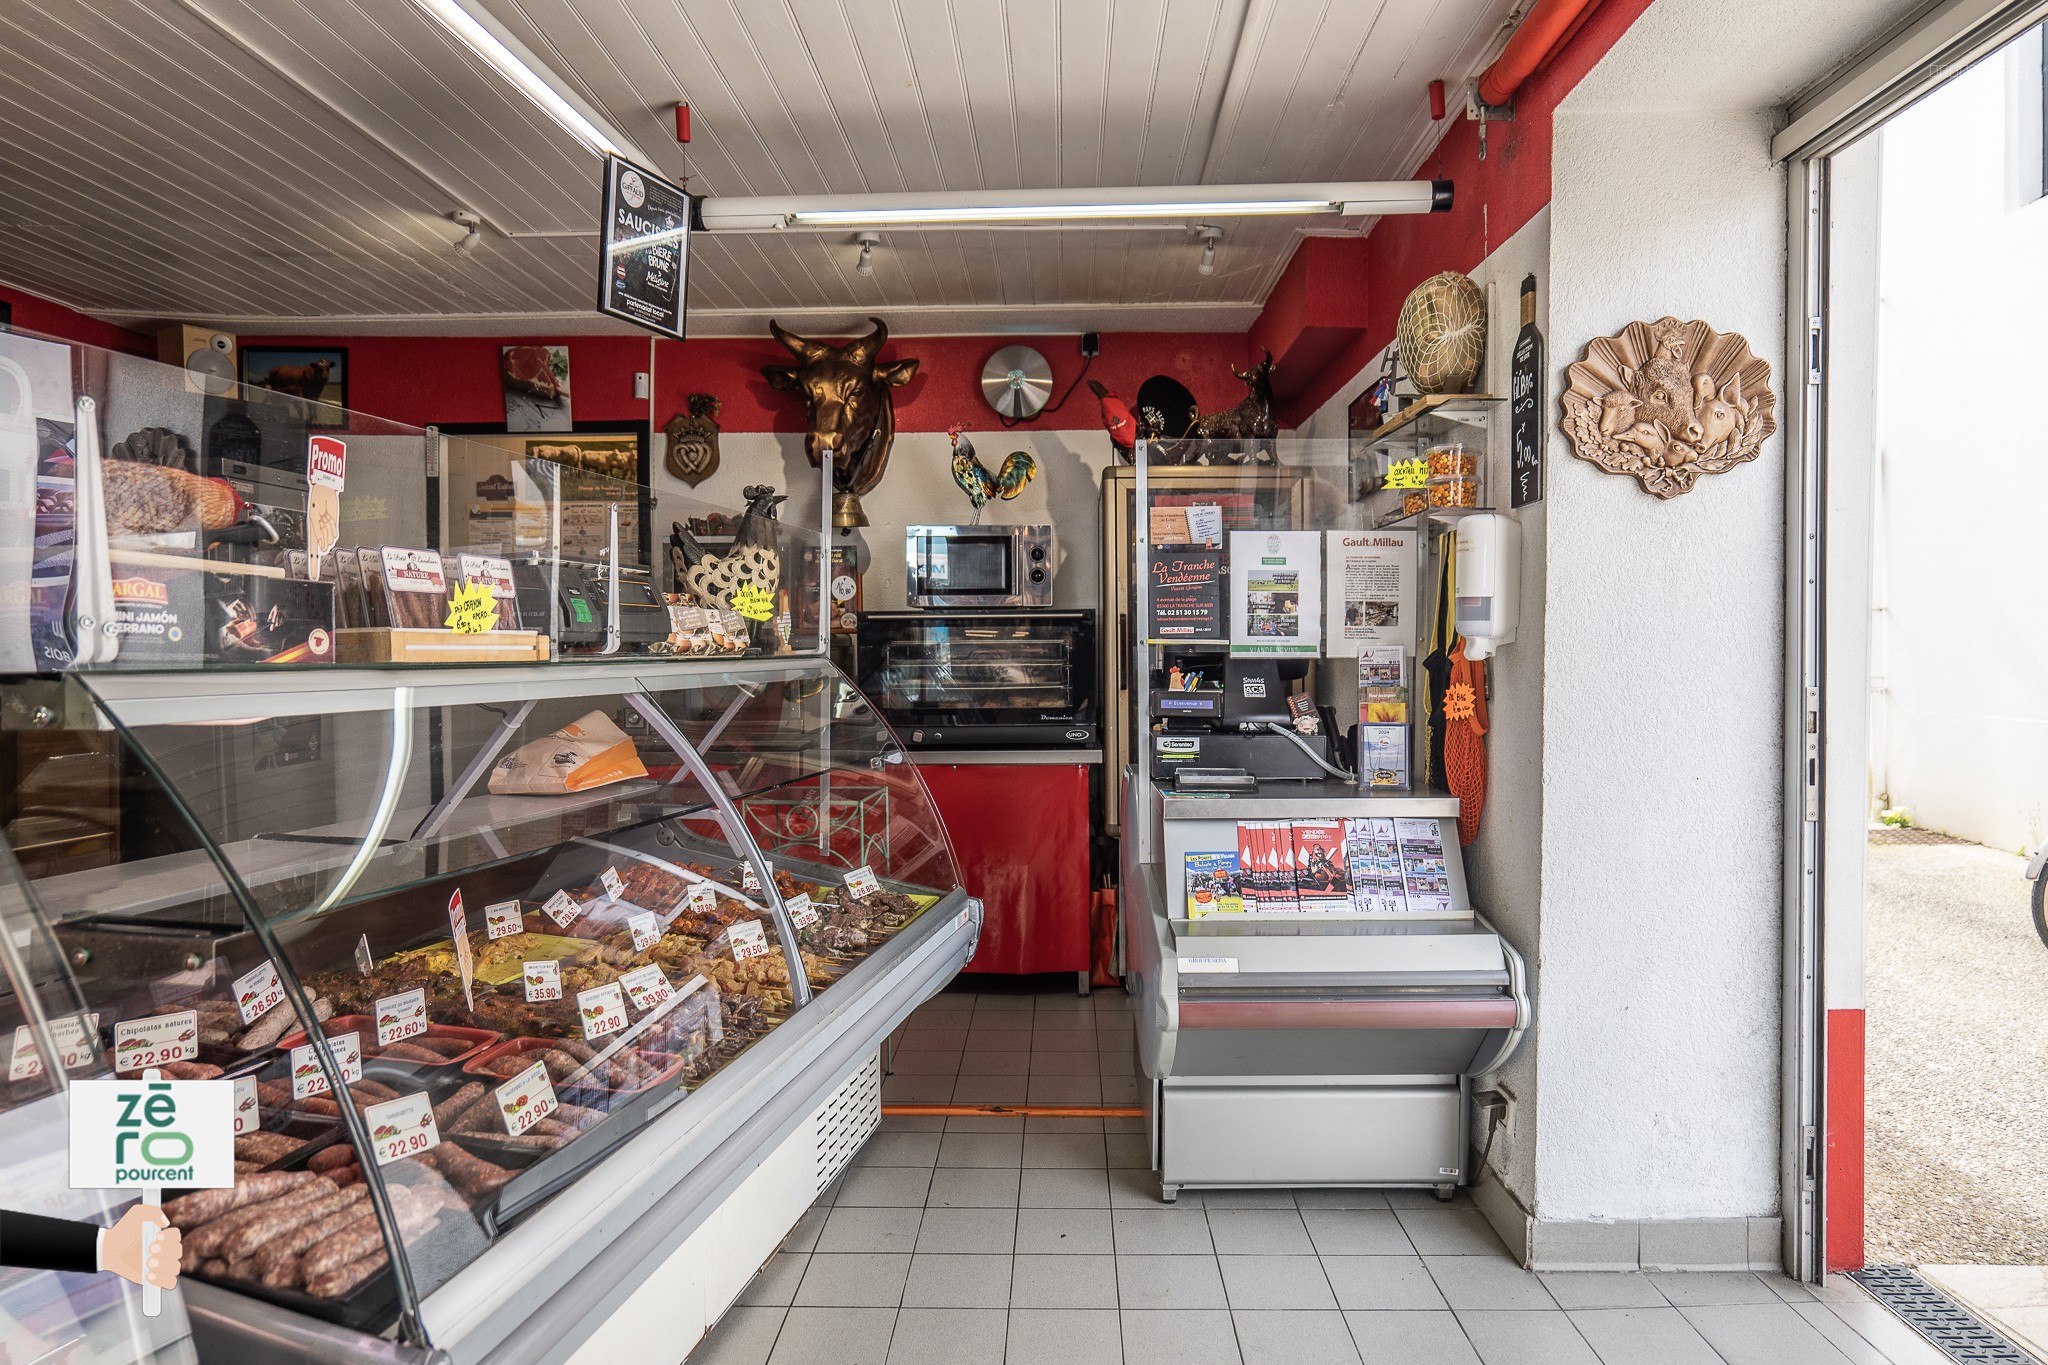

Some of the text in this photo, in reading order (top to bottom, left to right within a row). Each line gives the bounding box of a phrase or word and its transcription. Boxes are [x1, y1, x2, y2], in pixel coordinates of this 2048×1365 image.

[312, 444, 343, 476] Promo
[1152, 561, 1168, 573] La
[1172, 559, 1215, 572] Tranche
[403, 570, 429, 578] NATURE
[1159, 572, 1211, 584] Vendéenne
[114, 583, 164, 599] ARGAL
[136, 610, 178, 624] JAMÓN
[111, 622, 165, 634] ERRANO
[496, 923, 517, 936] 29.50
[741, 944, 762, 958] 29.50
[534, 987, 556, 999] 35.90
[252, 991, 278, 1016] 26.50
[121, 1019, 193, 1036] Chipolatas natures
[382, 1032, 387, 1040] €
[389, 1021, 418, 1040] 22.60
[594, 1015, 620, 1034] 22.90
[120, 1057, 129, 1066] €
[133, 1046, 182, 1067] 22.90
[297, 1084, 305, 1093] €
[512, 1122, 518, 1131] €
[518, 1100, 548, 1129] 22.90
[379, 1133, 428, 1157] € 22.90
